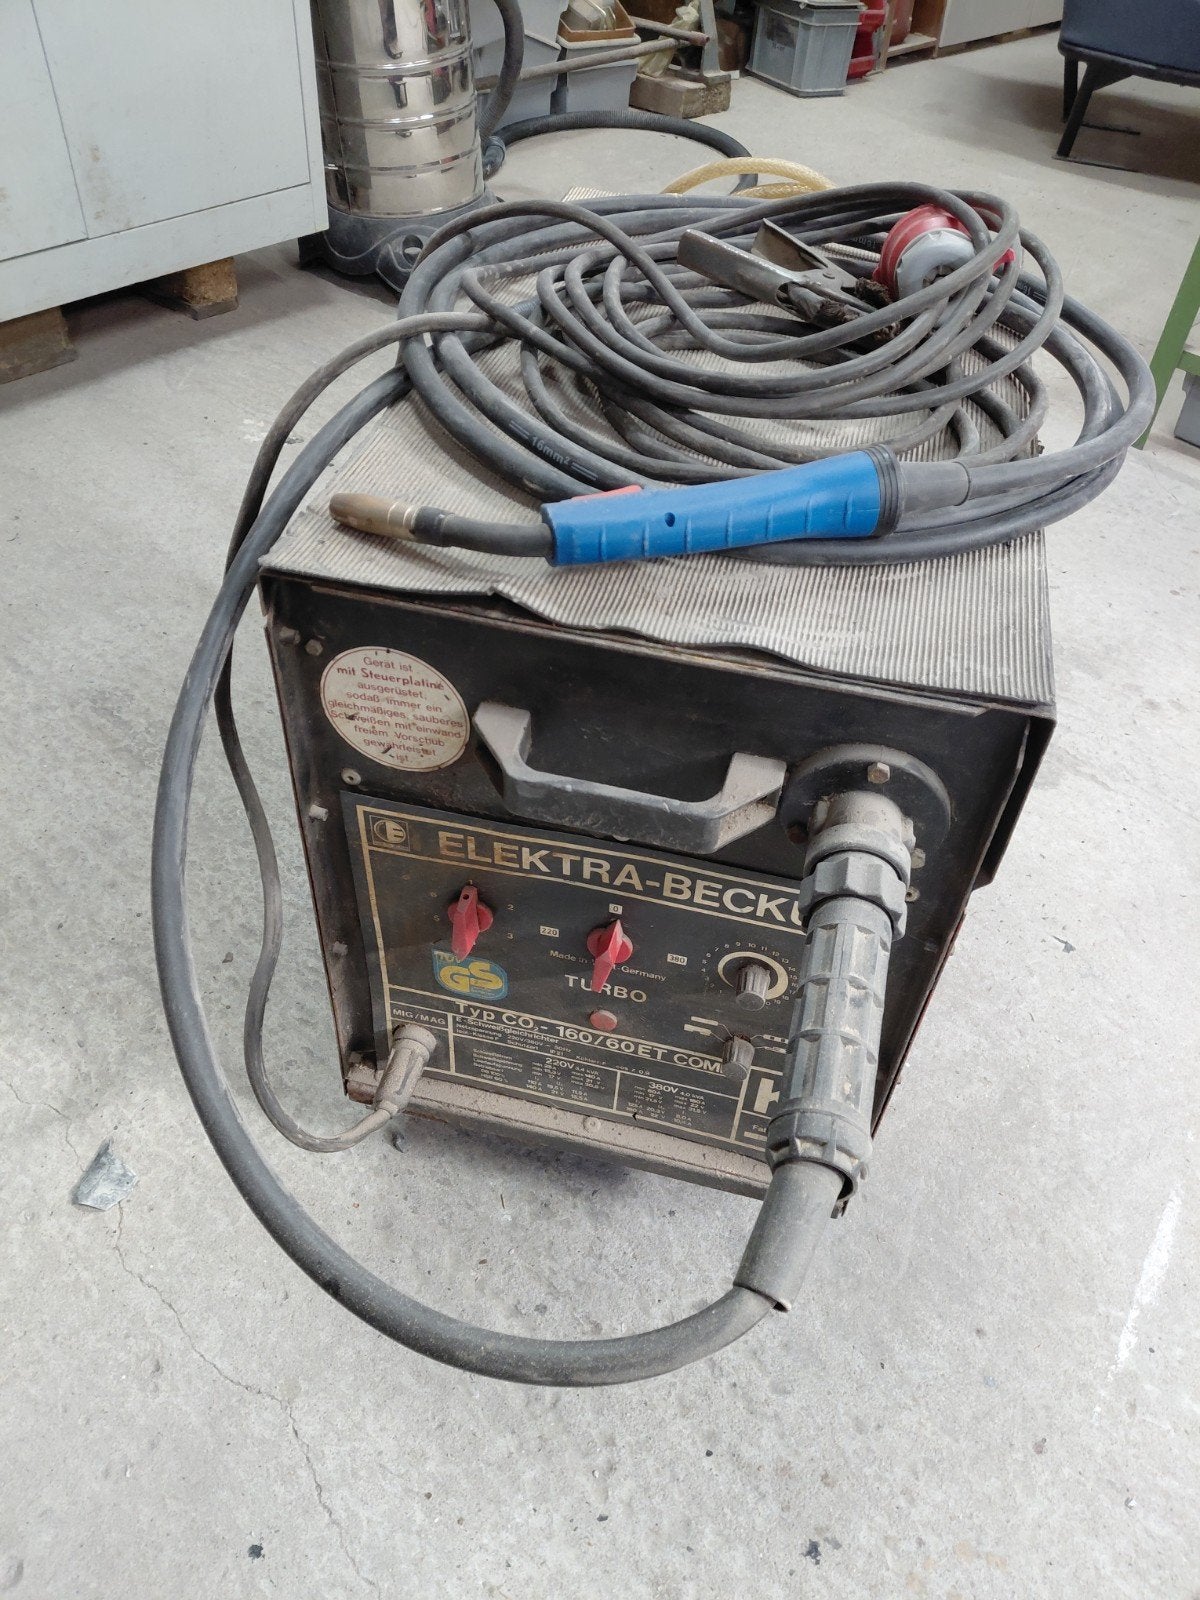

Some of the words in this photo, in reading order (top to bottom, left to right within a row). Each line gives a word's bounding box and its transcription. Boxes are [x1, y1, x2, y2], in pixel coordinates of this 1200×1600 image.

[532, 436, 571, 465] 16mm²
[363, 656, 396, 669] Gerät
[337, 666, 356, 676] mit
[360, 667, 445, 691] Steuerplatine
[357, 682, 427, 701] ausgerüstet,
[346, 691, 381, 703] sodaß
[386, 696, 422, 709] immer
[426, 704, 443, 714] ein
[394, 721, 412, 731] mit
[412, 713, 464, 728] sauberes
[354, 724, 389, 738] freiem
[393, 731, 446, 747] Vorschub
[507, 903, 514, 911] 2
[507, 932, 514, 940] 3
[541, 927, 558, 936] 220
[550, 950, 577, 961] Made
[578, 956, 588, 964] in
[668, 956, 686, 965] 380
[440, 960, 503, 994] GS
[564, 973, 648, 1003] TURBO
[392, 1008, 446, 1025] MIG/MAG
[454, 1000, 496, 1021] Typ
[673, 1053, 723, 1074] COM
[545, 1057, 576, 1069] 220V
[648, 1082, 679, 1094] 380V
